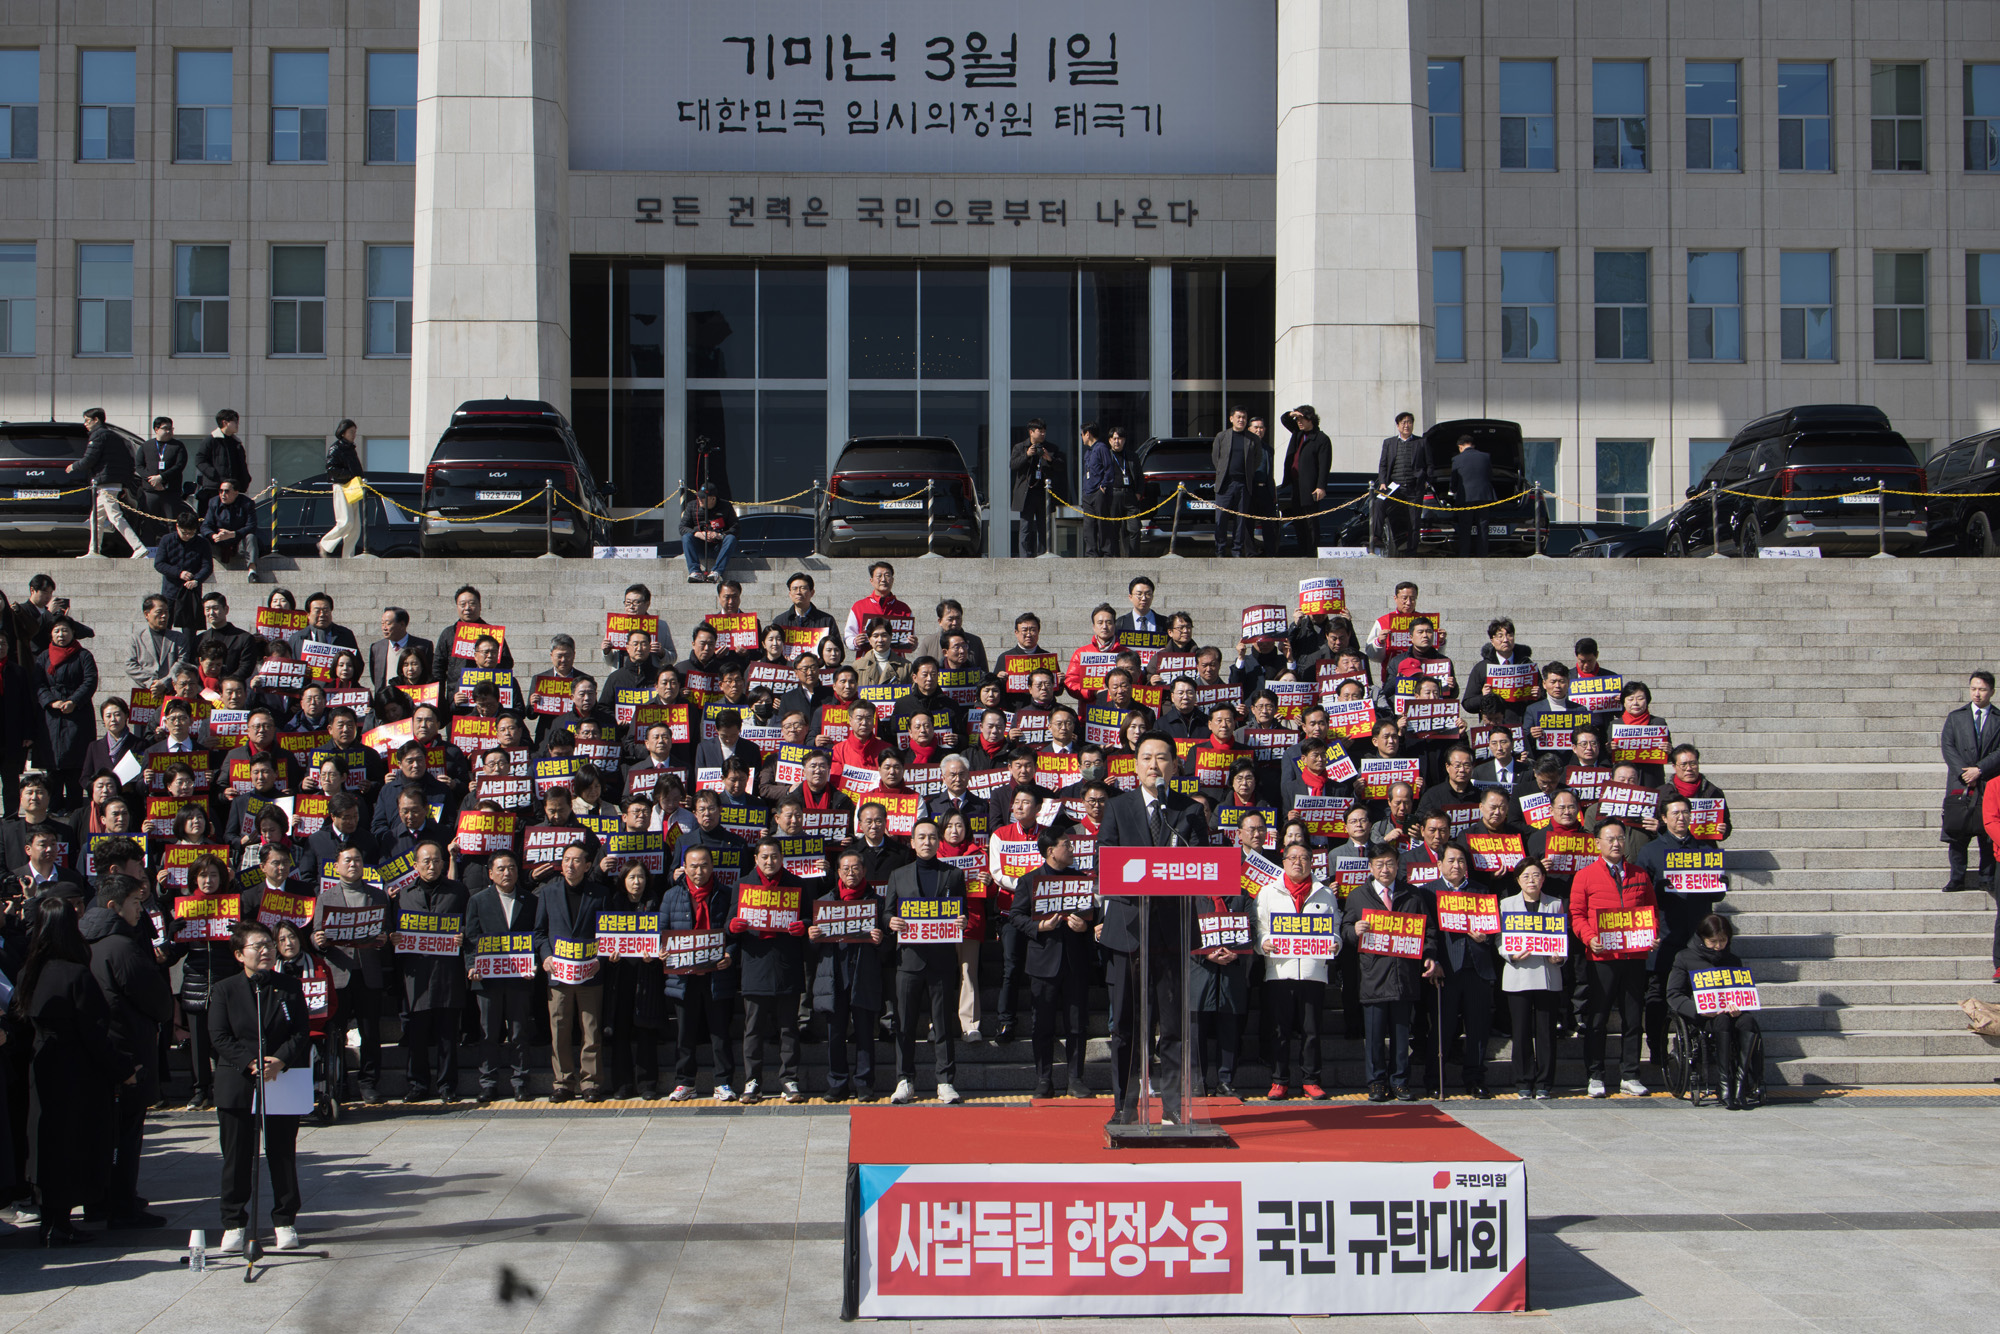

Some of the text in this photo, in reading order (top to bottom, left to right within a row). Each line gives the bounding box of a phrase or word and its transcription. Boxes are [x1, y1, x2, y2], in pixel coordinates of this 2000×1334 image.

[722, 33, 1120, 88] 기미년 3월 1일
[677, 97, 1164, 138] 대한민국 임시의정원 태극기
[635, 197, 1199, 228] 모든 권력은 국민으로부터 나온다
[1303, 590, 1341, 600] 대한민국
[258, 611, 291, 625] 사법파괴
[742, 617, 755, 630] 3법
[1244, 609, 1285, 624] 사법 파괴
[609, 617, 656, 632] 사법파괴 3법
[1265, 622, 1286, 632] 완성
[1120, 633, 1151, 645] 삼권분립
[281, 662, 305, 675] 파괴
[1008, 659, 1040, 672] 사법파괴
[1160, 657, 1180, 669] 사법
[494, 673, 512, 686] 파괴
[751, 667, 774, 679] 사법
[279, 676, 304, 687] 완성
[538, 680, 571, 694] 사법파괴
[1492, 676, 1537, 687] 대한민국
[1570, 678, 1622, 692] 삼권분립 파괴
[345, 690, 368, 703] 파괴
[618, 690, 650, 703] 삼권분립
[860, 687, 892, 699] 삼권분립
[1145, 690, 1160, 704] 3법
[1217, 687, 1241, 699] 파괴
[637, 707, 687, 724] 사법파괴 3법
[1088, 708, 1120, 725] 삼권분립
[1408, 702, 1457, 717] 사법 파괴
[1020, 716, 1047, 728] 사법
[1539, 713, 1573, 727] 삼권분립
[1088, 726, 1102, 742] 당장
[1274, 733, 1299, 746] 파괴
[1614, 727, 1658, 737] 사법파괴 악법
[1618, 738, 1663, 749] 대한민국
[1615, 750, 1639, 761] 헌정
[536, 760, 569, 775] 삼권분립
[1363, 761, 1408, 772] 사법파괴 악법
[632, 774, 655, 788] 사법
[1368, 773, 1413, 783] 대한민국
[1569, 771, 1595, 784] 사법
[480, 779, 530, 794] 사법 파괴
[1365, 786, 1387, 797] 헌정
[505, 795, 530, 808] 완성
[1604, 787, 1658, 803] 사법 파괴
[900, 798, 917, 813] 3법
[1297, 798, 1326, 808] 사법파괴
[1601, 801, 1655, 818] 독재 완성
[460, 816, 514, 832] 사법파괴 3법
[750, 809, 766, 825] 파괴
[822, 813, 847, 826] 파괴
[529, 832, 554, 845] 사법
[609, 833, 663, 851] 삼권분립 파괴
[805, 837, 823, 853] 파괴
[1470, 837, 1521, 852] 사법파괴 3법
[1548, 836, 1584, 853] 사법파괴
[526, 847, 553, 863] 독재
[1474, 853, 1499, 869] 대통령은
[1666, 853, 1723, 869] 삼권분립 파괴
[1152, 862, 1218, 880] 국민의힘
[1410, 866, 1438, 880] 사법
[1036, 880, 1093, 897] 사법 파괴
[262, 892, 314, 915] 사법파괴 3법
[742, 889, 798, 907] 사법파괴 3법
[1035, 896, 1093, 913] 독재 완성
[1440, 896, 1496, 912] 사법파괴 3법
[178, 898, 238, 917] 사법파괴 3법
[817, 904, 876, 920] 사법 파괴
[901, 901, 960, 917] 삼권분립 파괴
[325, 908, 384, 928] 사법 파괴
[400, 913, 460, 932] 삼권분립 파괴
[598, 914, 658, 931] 삼권분립 파괴
[1220, 916, 1248, 929] 파괴
[1272, 916, 1332, 933] 삼권분립 파괴
[1440, 912, 1497, 932] 대통령은 거부하라!
[1505, 914, 1564, 932] 삼권분립 파괴
[1599, 910, 1652, 929] 사법파괴 3법
[352, 922, 382, 938] 완성
[846, 920, 874, 932] 완성
[1406, 918, 1423, 935] 3법
[478, 934, 532, 952] 삼권분립 파괴
[598, 936, 657, 954] 당장 중단하라!
[666, 933, 723, 950] 사법 파괴
[1220, 932, 1249, 944] 완성
[1360, 932, 1420, 956] 대통령은 거부하라!
[1504, 936, 1522, 951] 당장
[554, 938, 583, 956] 삼권분립
[1274, 938, 1290, 954] 당장
[695, 948, 723, 962] 완성
[476, 954, 532, 974] 당장 중단하라!
[1693, 970, 1752, 988] 삼권분립 파괴
[1698, 992, 1716, 1010] 당장
[1456, 1173, 1507, 1189] 국민의힘
[891, 1199, 1509, 1277] 사법독립 헌정수호 국민 규탄대회
